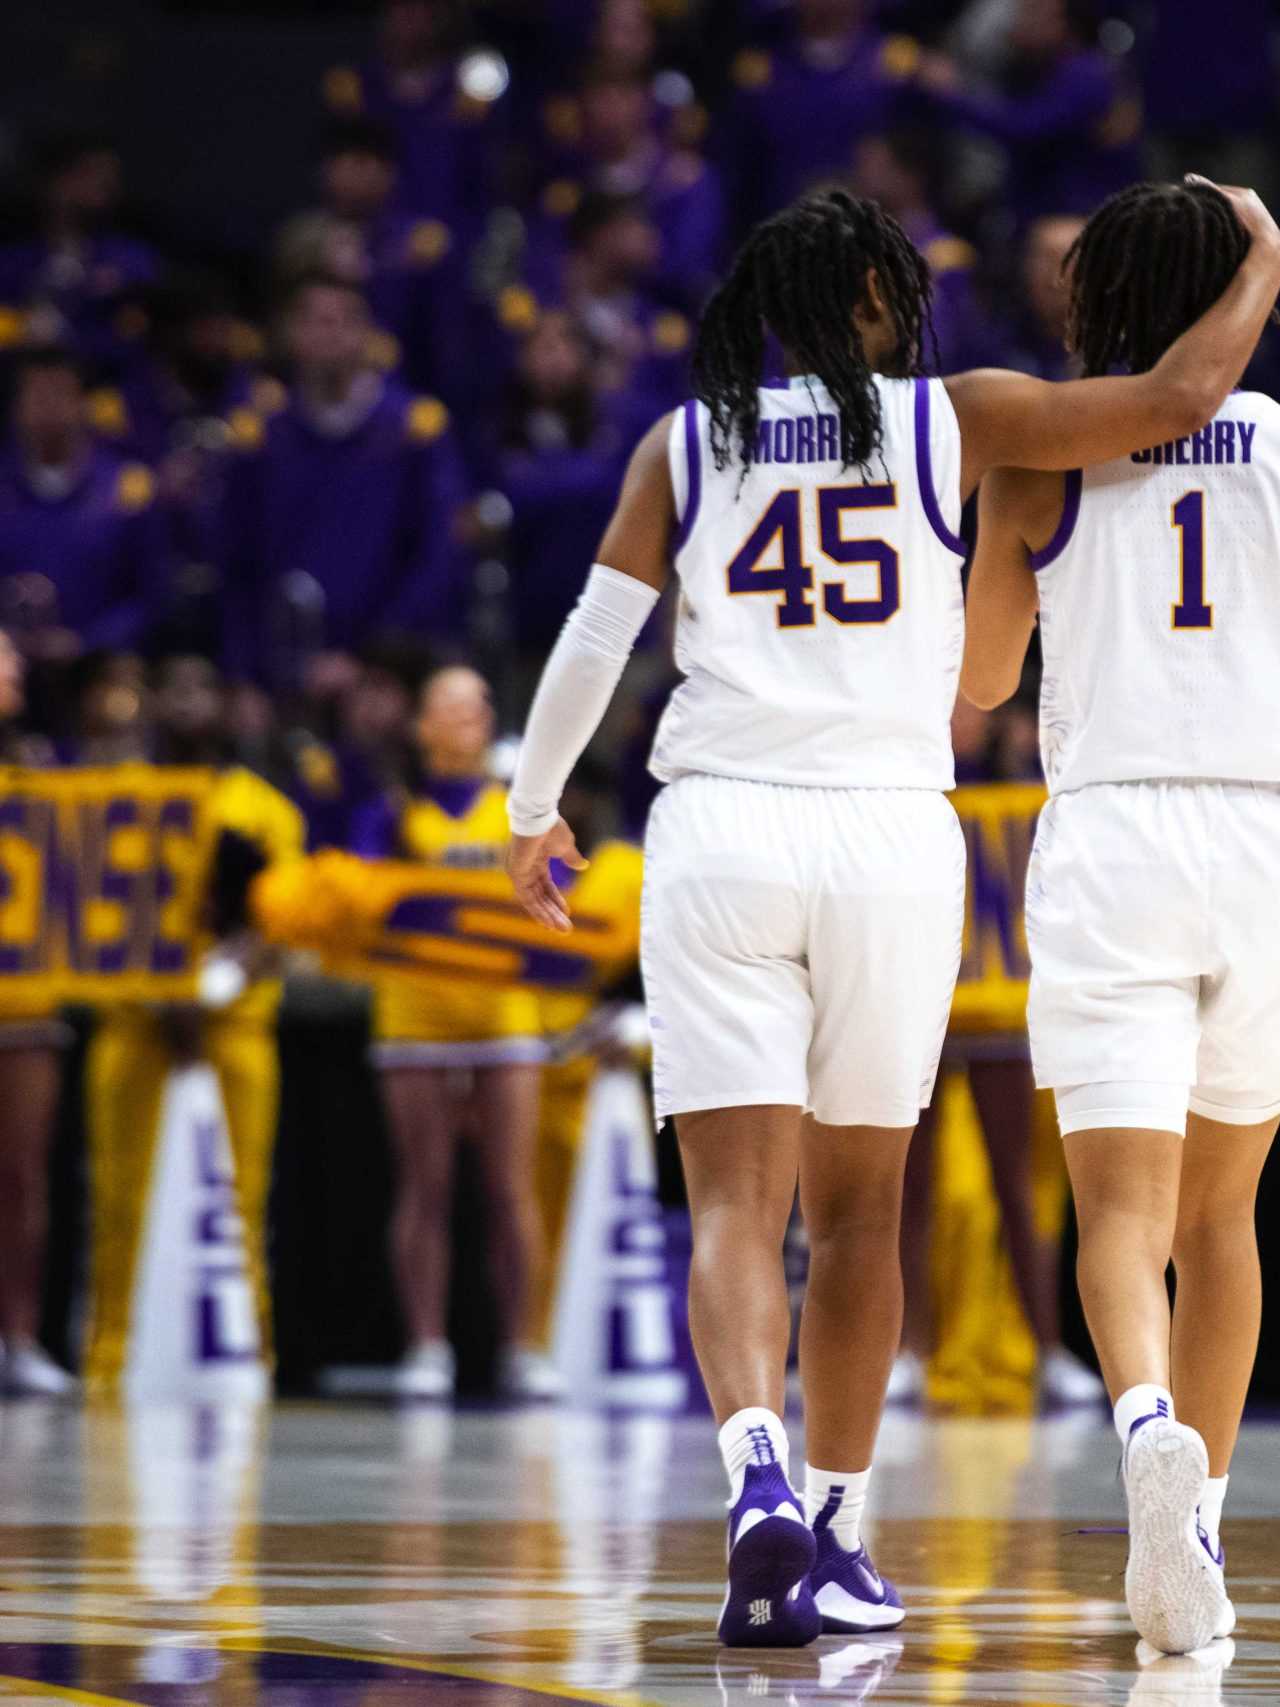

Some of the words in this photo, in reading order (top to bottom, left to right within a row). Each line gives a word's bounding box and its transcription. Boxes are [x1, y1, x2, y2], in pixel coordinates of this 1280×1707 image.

[747, 413, 846, 464] MORR
[726, 482, 902, 629] 45
[1171, 489, 1213, 631] 1
